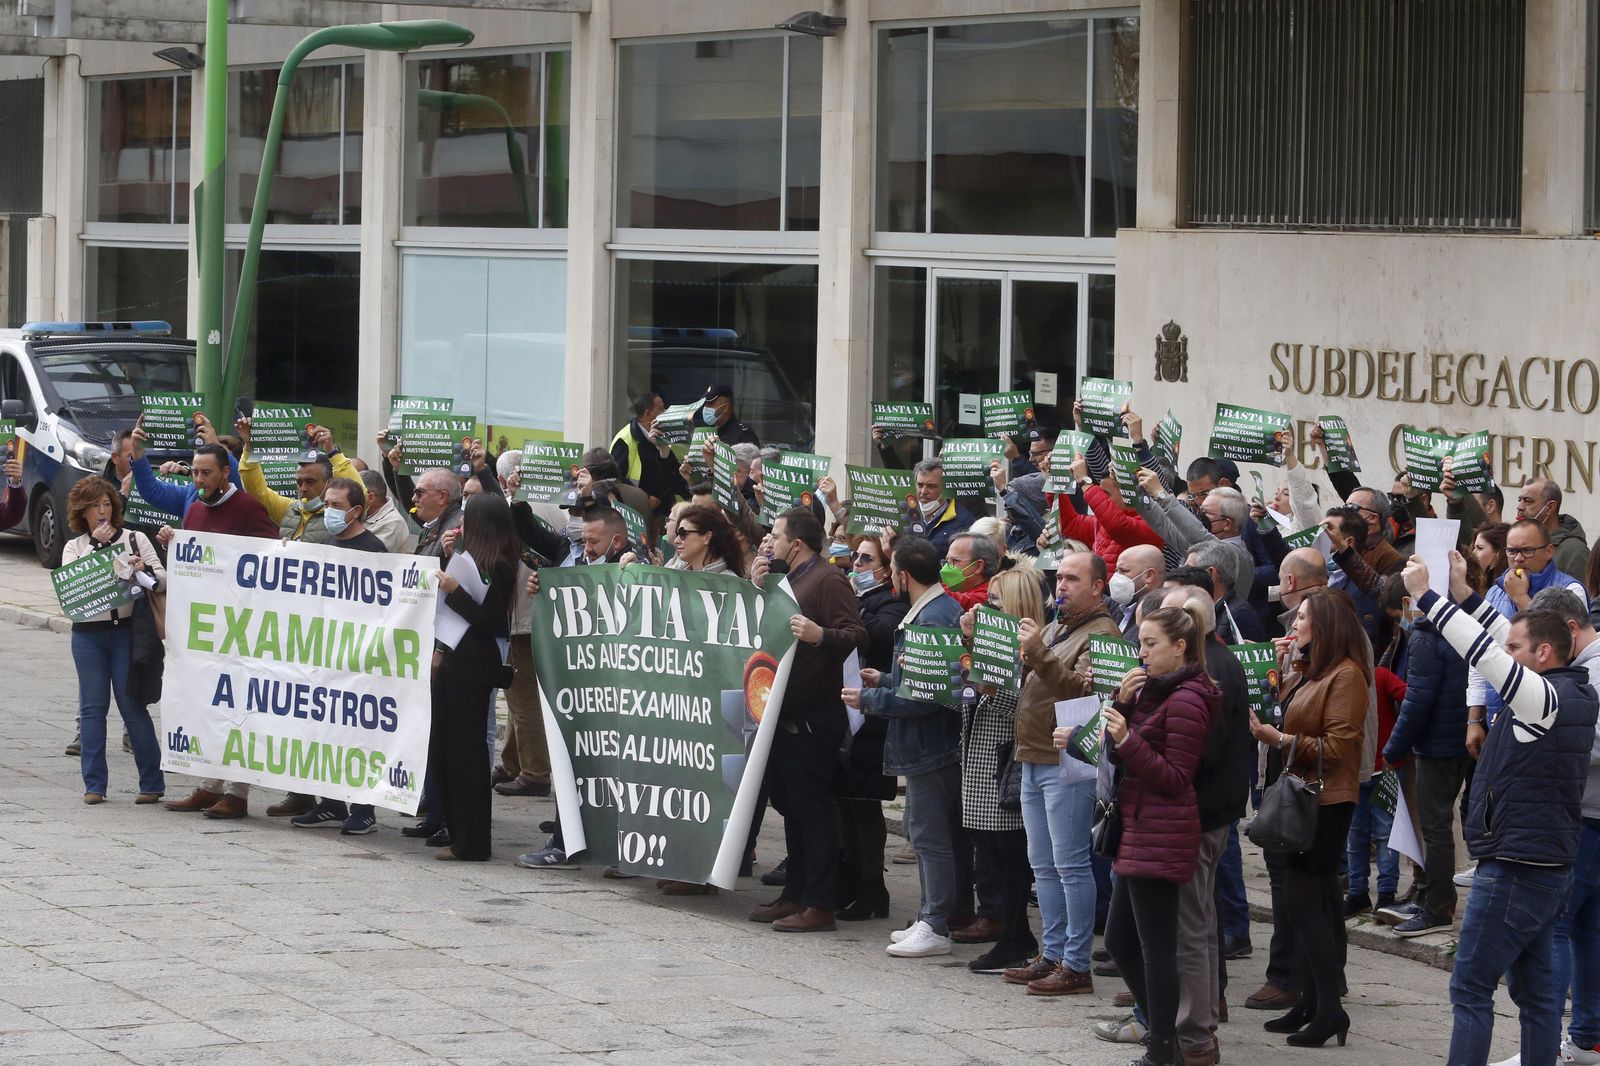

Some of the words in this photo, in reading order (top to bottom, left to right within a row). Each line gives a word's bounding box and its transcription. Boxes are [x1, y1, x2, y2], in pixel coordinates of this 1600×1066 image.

[1269, 342, 1600, 414] SUBDELEGACIO
[141, 395, 178, 406] ¡BASTA
[181, 397, 202, 406] YA!
[393, 399, 429, 410] ¡BASTA
[432, 401, 450, 411] YA!
[983, 396, 1012, 407] ¡BASTA
[1012, 394, 1029, 403] YA!
[291, 408, 312, 418] YA!
[874, 404, 914, 414] ¡BASTA
[915, 406, 930, 415] YA!
[1219, 407, 1263, 424] ¡BASTA
[1266, 415, 1287, 427] YA!
[405, 419, 448, 431] ¡BASTA
[451, 420, 472, 431] YA!
[1214, 426, 1239, 435] QUEREMOS
[1240, 429, 1264, 438] EXAMINAR
[1228, 421, 1263, 431] AUTOESCUELAS
[1072, 435, 1089, 447] YA!
[1216, 433, 1240, 441] NUESTROS
[1241, 437, 1265, 445] ALUMNOS
[1437, 438, 1454, 450] YA!
[525, 444, 558, 457] ¡BASTA
[560, 447, 579, 458] YA!
[944, 442, 982, 453] ¡BASTA
[982, 443, 1002, 454] YA!
[1228, 444, 1263, 455] SERVICIO
[1124, 452, 1137, 463] YA!
[812, 459, 828, 471] YA!
[789, 471, 810, 485] YA!
[850, 470, 888, 486] ¡BASTA
[889, 474, 911, 487] YA!
[533, 485, 561, 493] SERVICIO
[144, 510, 179, 521] SERVICIO
[870, 516, 899, 526] SERVICIO
[54, 557, 100, 584] ¡BASTA
[60, 583, 70, 592] LAS
[70, 568, 107, 588] AUTOESCUELAS
[236, 553, 393, 606] QUEREMOS
[60, 584, 86, 600] QUEREMOS
[66, 590, 92, 605] NUESTROS
[91, 580, 116, 595] ALUMNOS
[83, 591, 118, 611] SERVICIO
[549, 583, 690, 642] ¡BASTA
[696, 589, 765, 650] YA!
[977, 611, 1009, 631] ¡BASTA
[187, 601, 419, 680] EXAMINAR
[905, 629, 939, 646] ¡BASTA
[985, 630, 1012, 643] AUTOESCUELAS
[973, 637, 996, 648] QUEREMOS
[995, 642, 1014, 653] EXAMINAR
[1091, 640, 1124, 656] ¡BASTA
[566, 643, 595, 670] LAS
[923, 658, 947, 667] EXAMINAR
[977, 648, 997, 659] NUESTROS
[996, 652, 1014, 663] ALUMNOS
[1252, 648, 1274, 663] YA!
[921, 666, 949, 676] ALUMNOS
[988, 664, 1013, 677] SERVICIO
[914, 680, 947, 691] SERVICIO
[211, 673, 235, 708] A
[246, 677, 398, 733] NUESTROS
[619, 688, 712, 725] EXAMINAR
[222, 728, 386, 789] ALUMNOS
[622, 734, 715, 771] ALUMNOS
